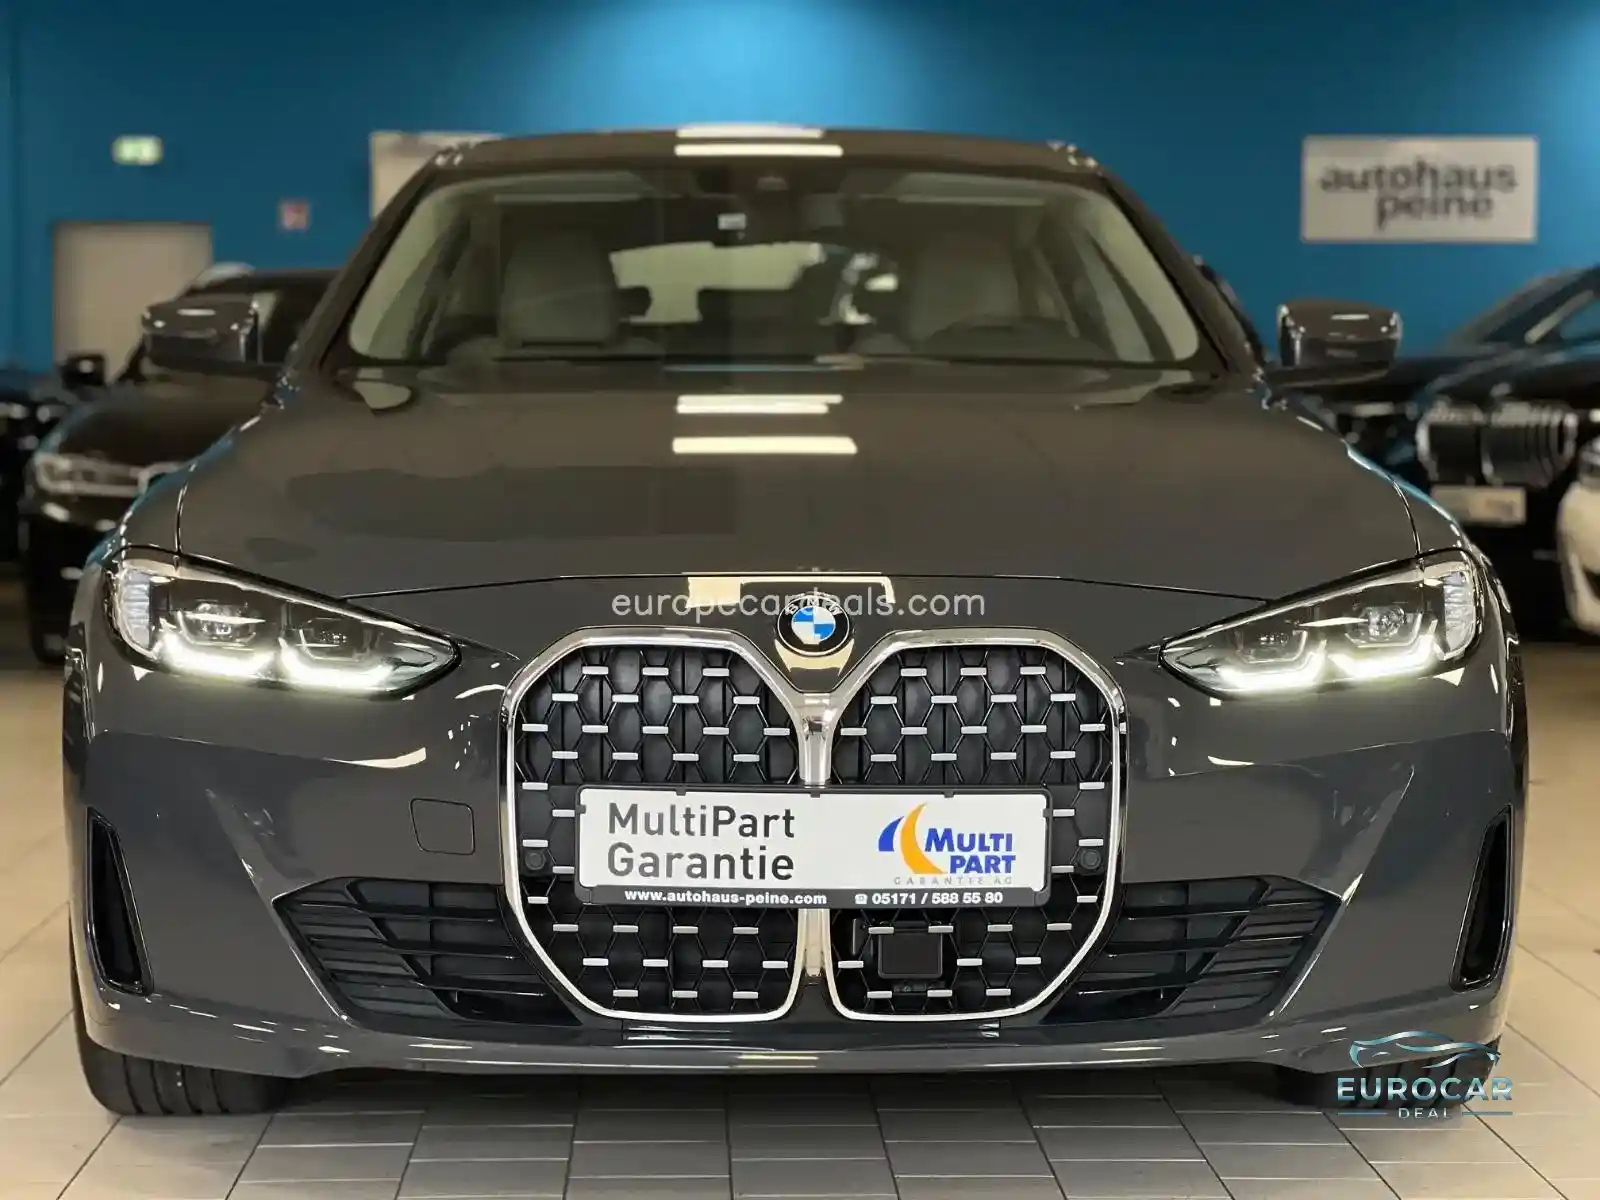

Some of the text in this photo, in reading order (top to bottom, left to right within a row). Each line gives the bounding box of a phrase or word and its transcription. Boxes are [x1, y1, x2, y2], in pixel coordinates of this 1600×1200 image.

[1320, 157, 1518, 192] autohaus
[1376, 197, 1494, 230] peine
[785, 594, 843, 616] BMW
[608, 802, 796, 838] MultiPart
[607, 841, 795, 881] Garantie
[949, 854, 1017, 874] PART
[893, 876, 984, 886] GARANTIE
[624, 889, 828, 905] www.autohaus-peine.com
[871, 891, 1004, 905] 05171 / 588 55 80
